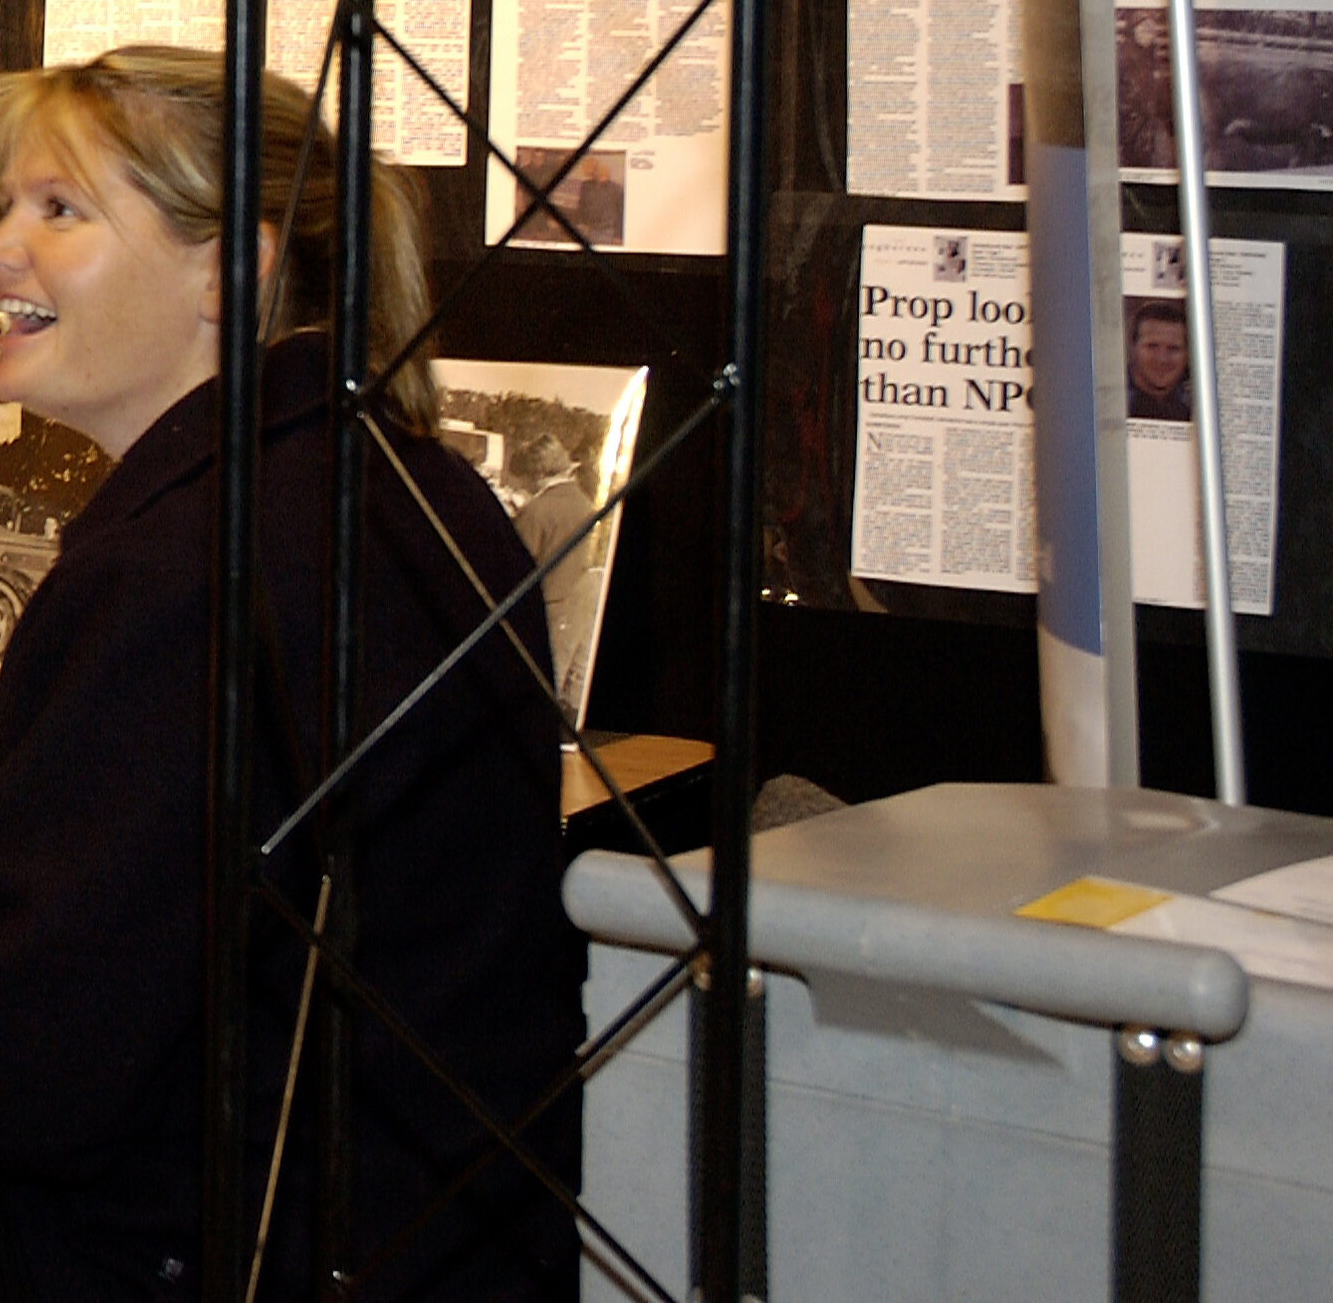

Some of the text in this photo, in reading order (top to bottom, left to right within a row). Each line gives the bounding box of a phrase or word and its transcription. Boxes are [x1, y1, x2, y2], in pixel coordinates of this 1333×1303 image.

[861, 284, 1033, 328] Prop loo
[861, 330, 1034, 371] no furth
[860, 370, 950, 409] than
